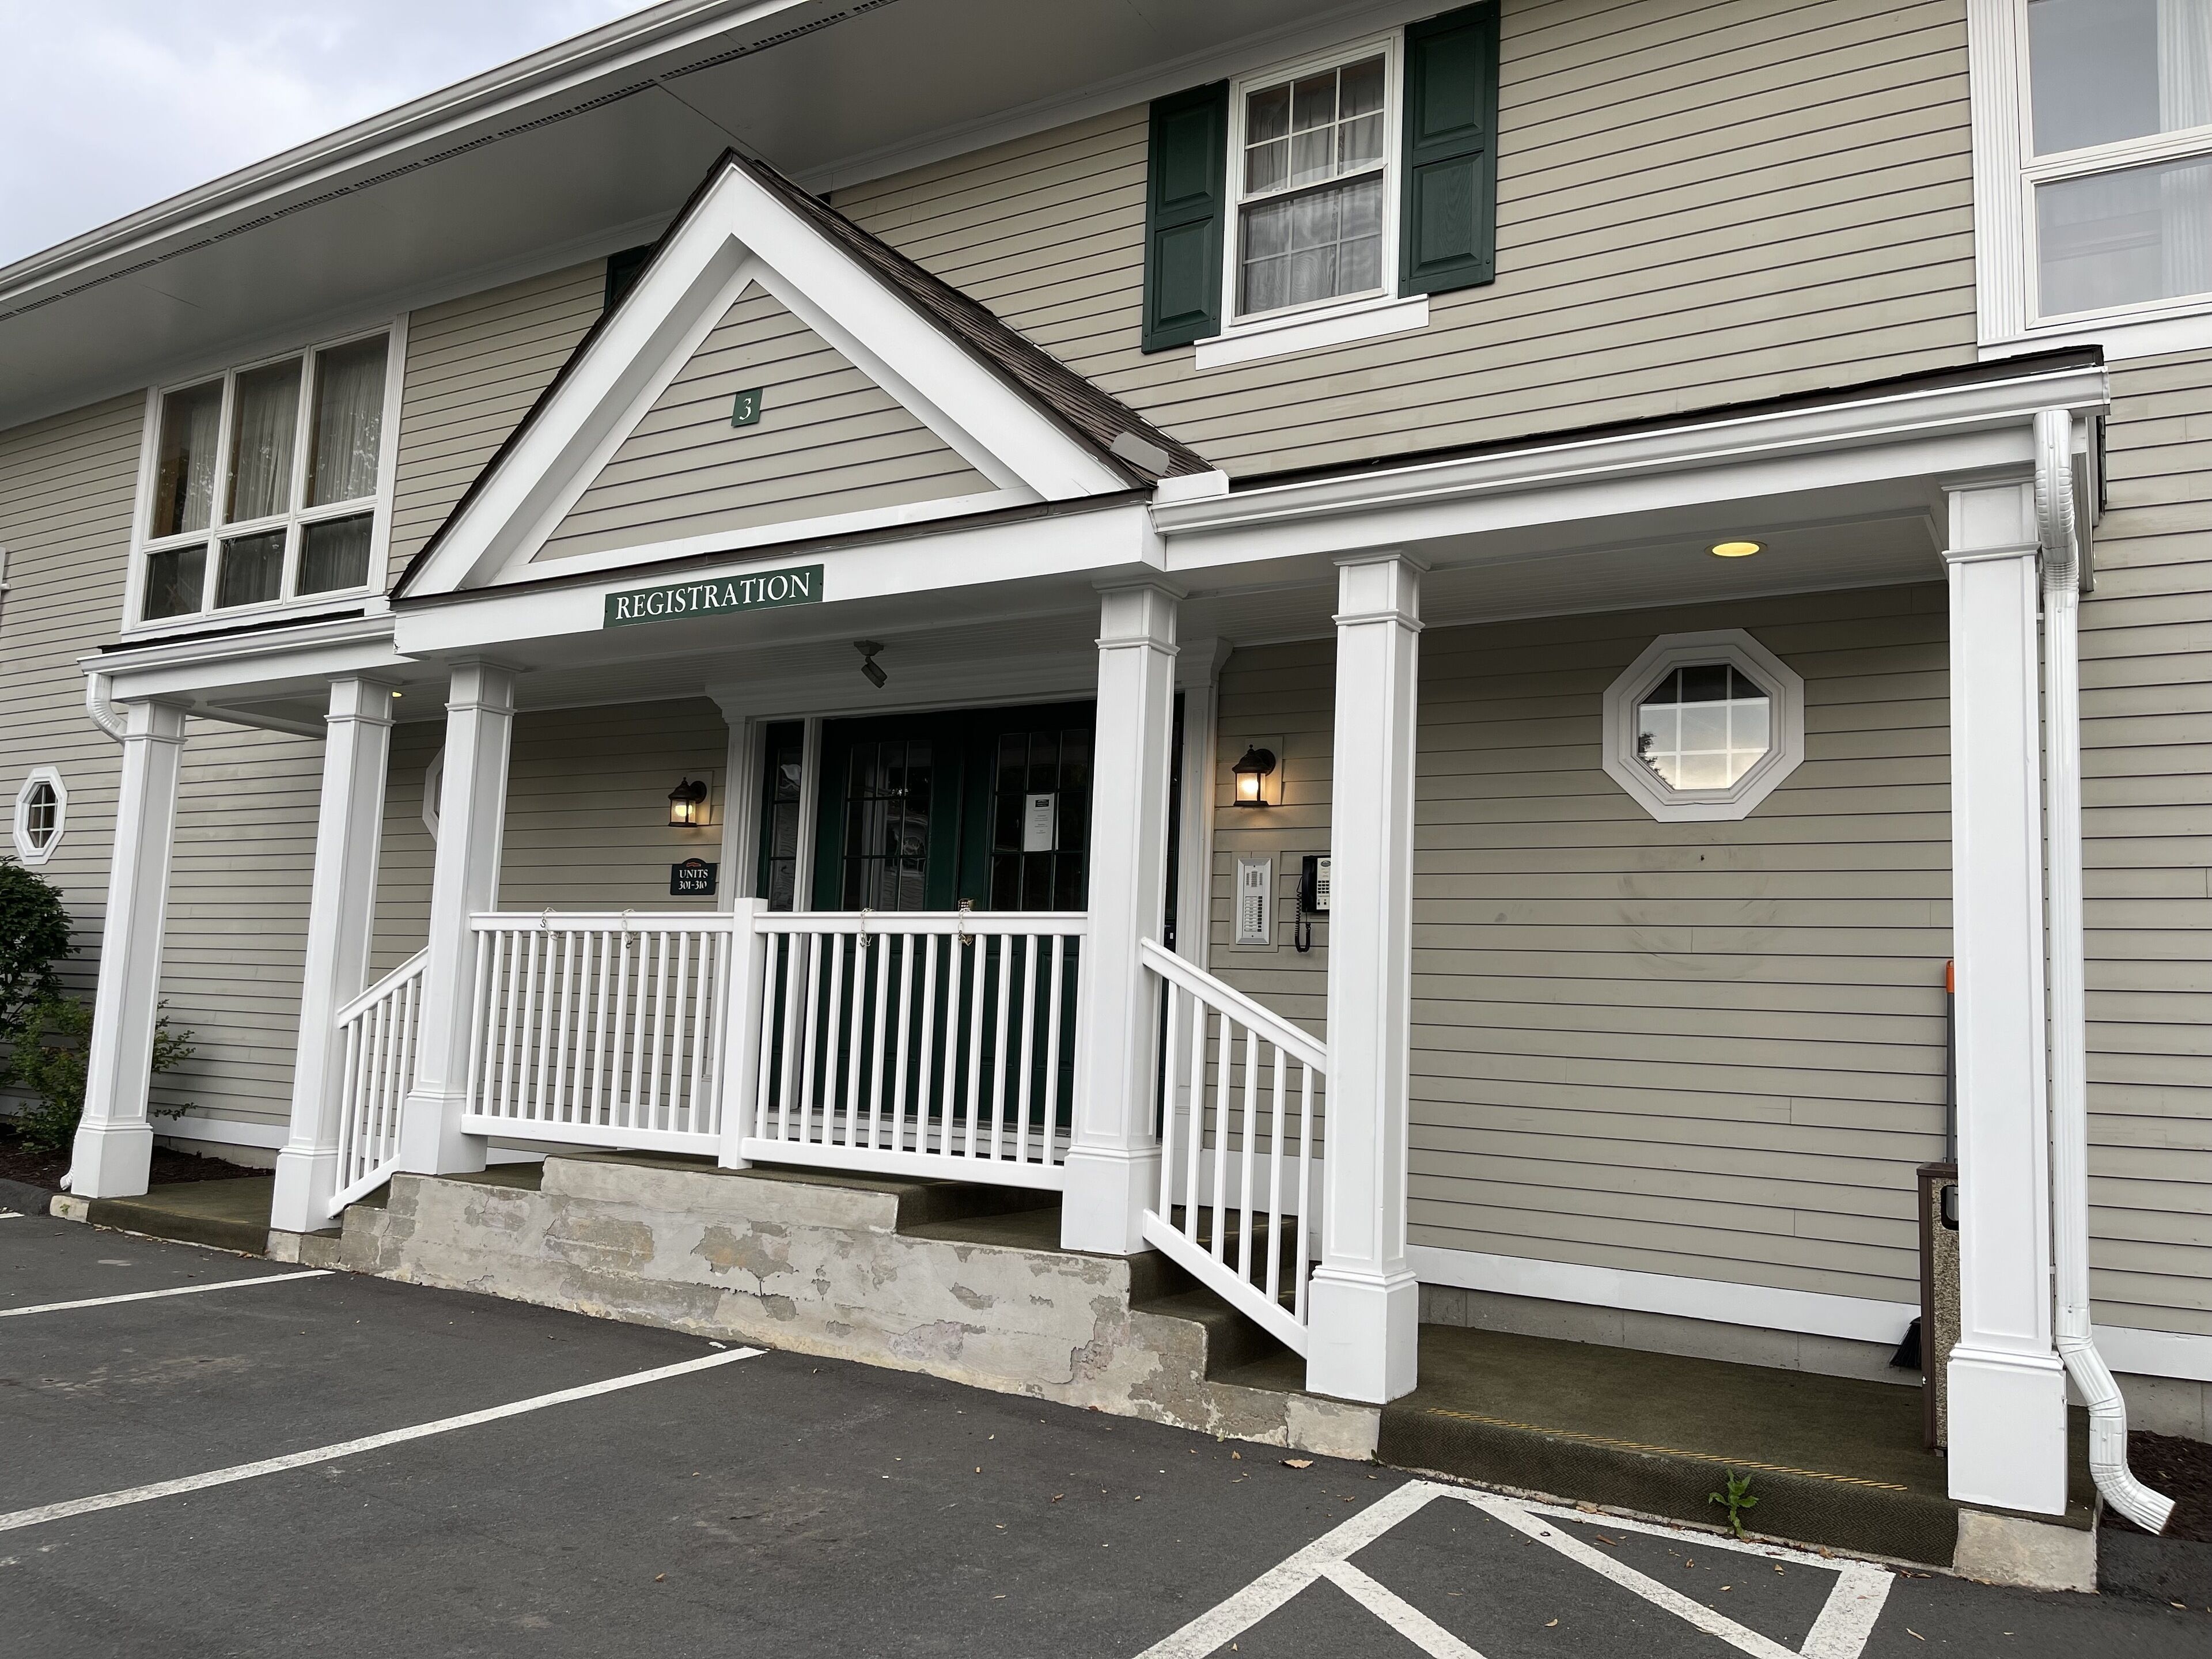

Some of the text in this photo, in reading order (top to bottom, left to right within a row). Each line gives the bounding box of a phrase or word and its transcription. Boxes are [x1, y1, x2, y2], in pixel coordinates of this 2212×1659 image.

[739, 397, 752, 421] 3
[615, 572, 811, 620] REGISTRATION
[679, 869, 709, 878] UNITS
[678, 880, 707, 890] 301-310
